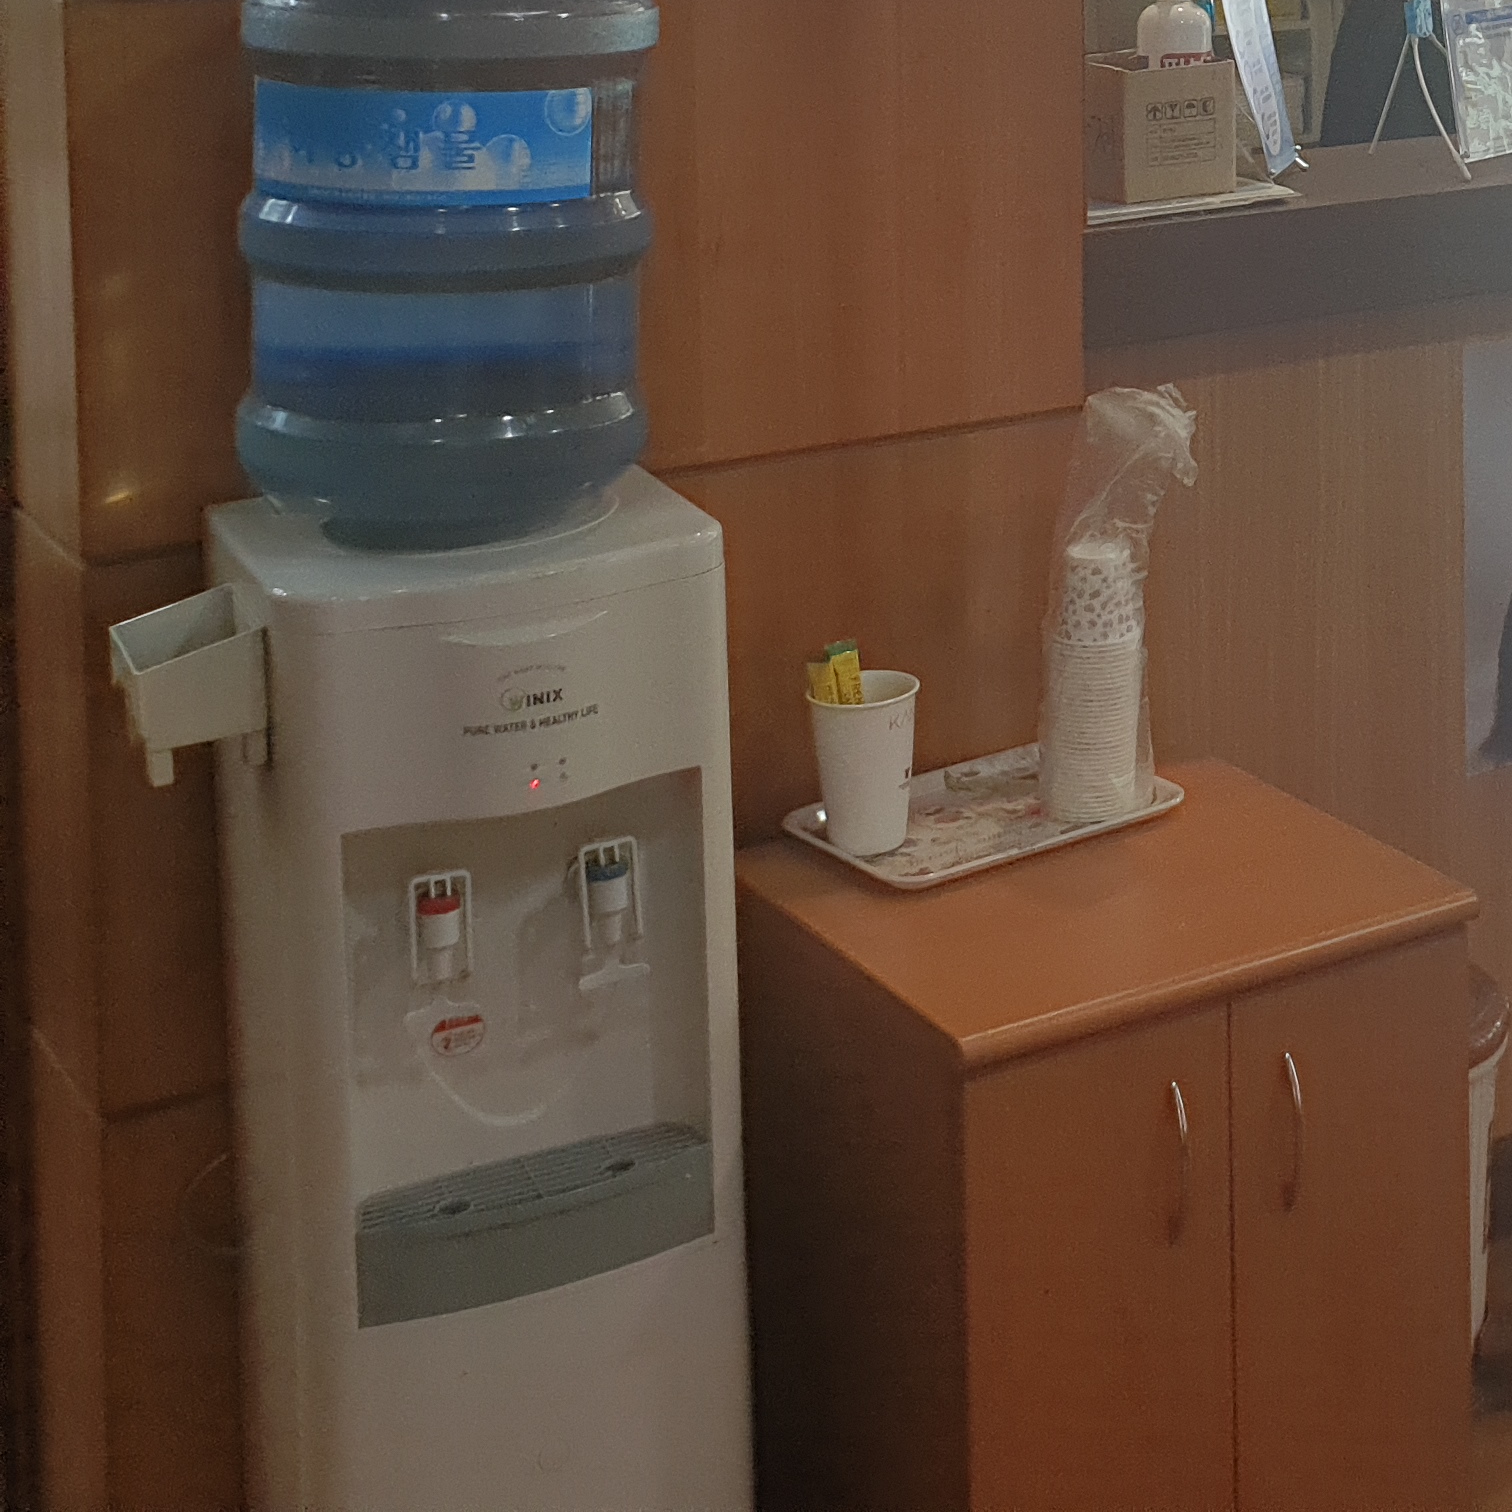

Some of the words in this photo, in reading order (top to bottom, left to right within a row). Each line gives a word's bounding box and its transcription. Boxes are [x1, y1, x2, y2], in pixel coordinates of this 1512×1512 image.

[494, 719, 528, 735] WATER
[539, 711, 579, 728] HEALTHY
[580, 703, 599, 719] LIFE
